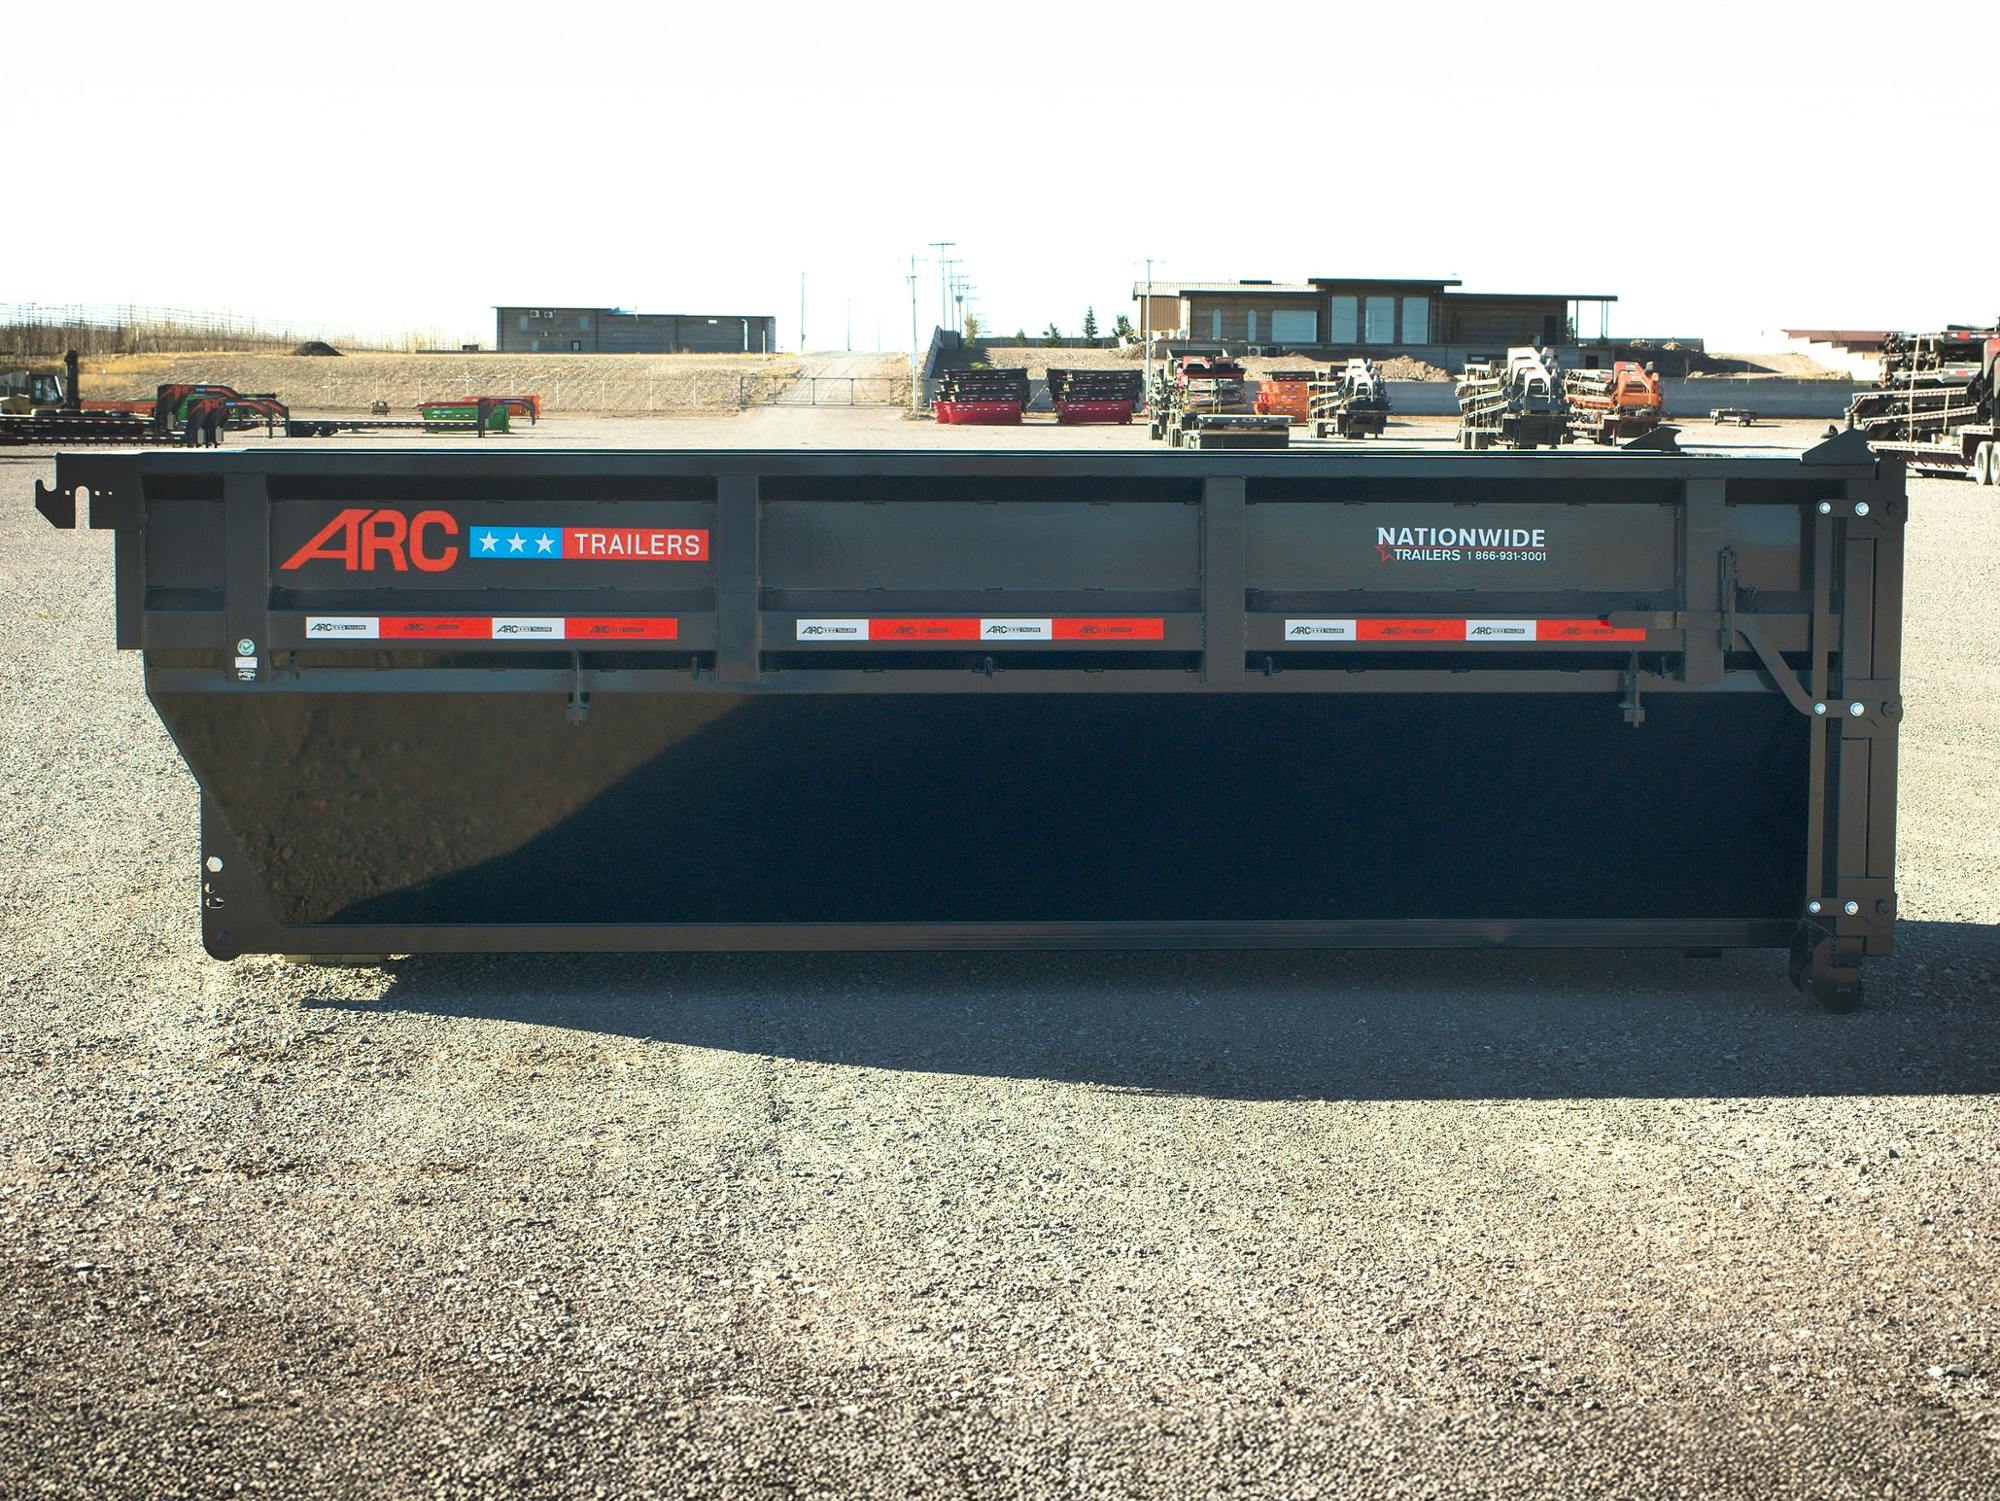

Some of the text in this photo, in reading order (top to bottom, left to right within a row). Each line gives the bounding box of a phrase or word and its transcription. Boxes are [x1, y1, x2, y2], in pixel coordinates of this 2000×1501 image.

[279, 508, 700, 572] ARC TRAILERS
[1377, 527, 1545, 547] NATIONWIDE
[1394, 549, 1547, 561] TRAILERS 1 866-931-3001
[311, 623, 332, 631] ARC
[497, 625, 518, 633] ARC
[802, 626, 823, 634] ARC
[986, 625, 1007, 633] ARC
[1290, 626, 1311, 634] ARC
[1471, 626, 1492, 635] ARC
